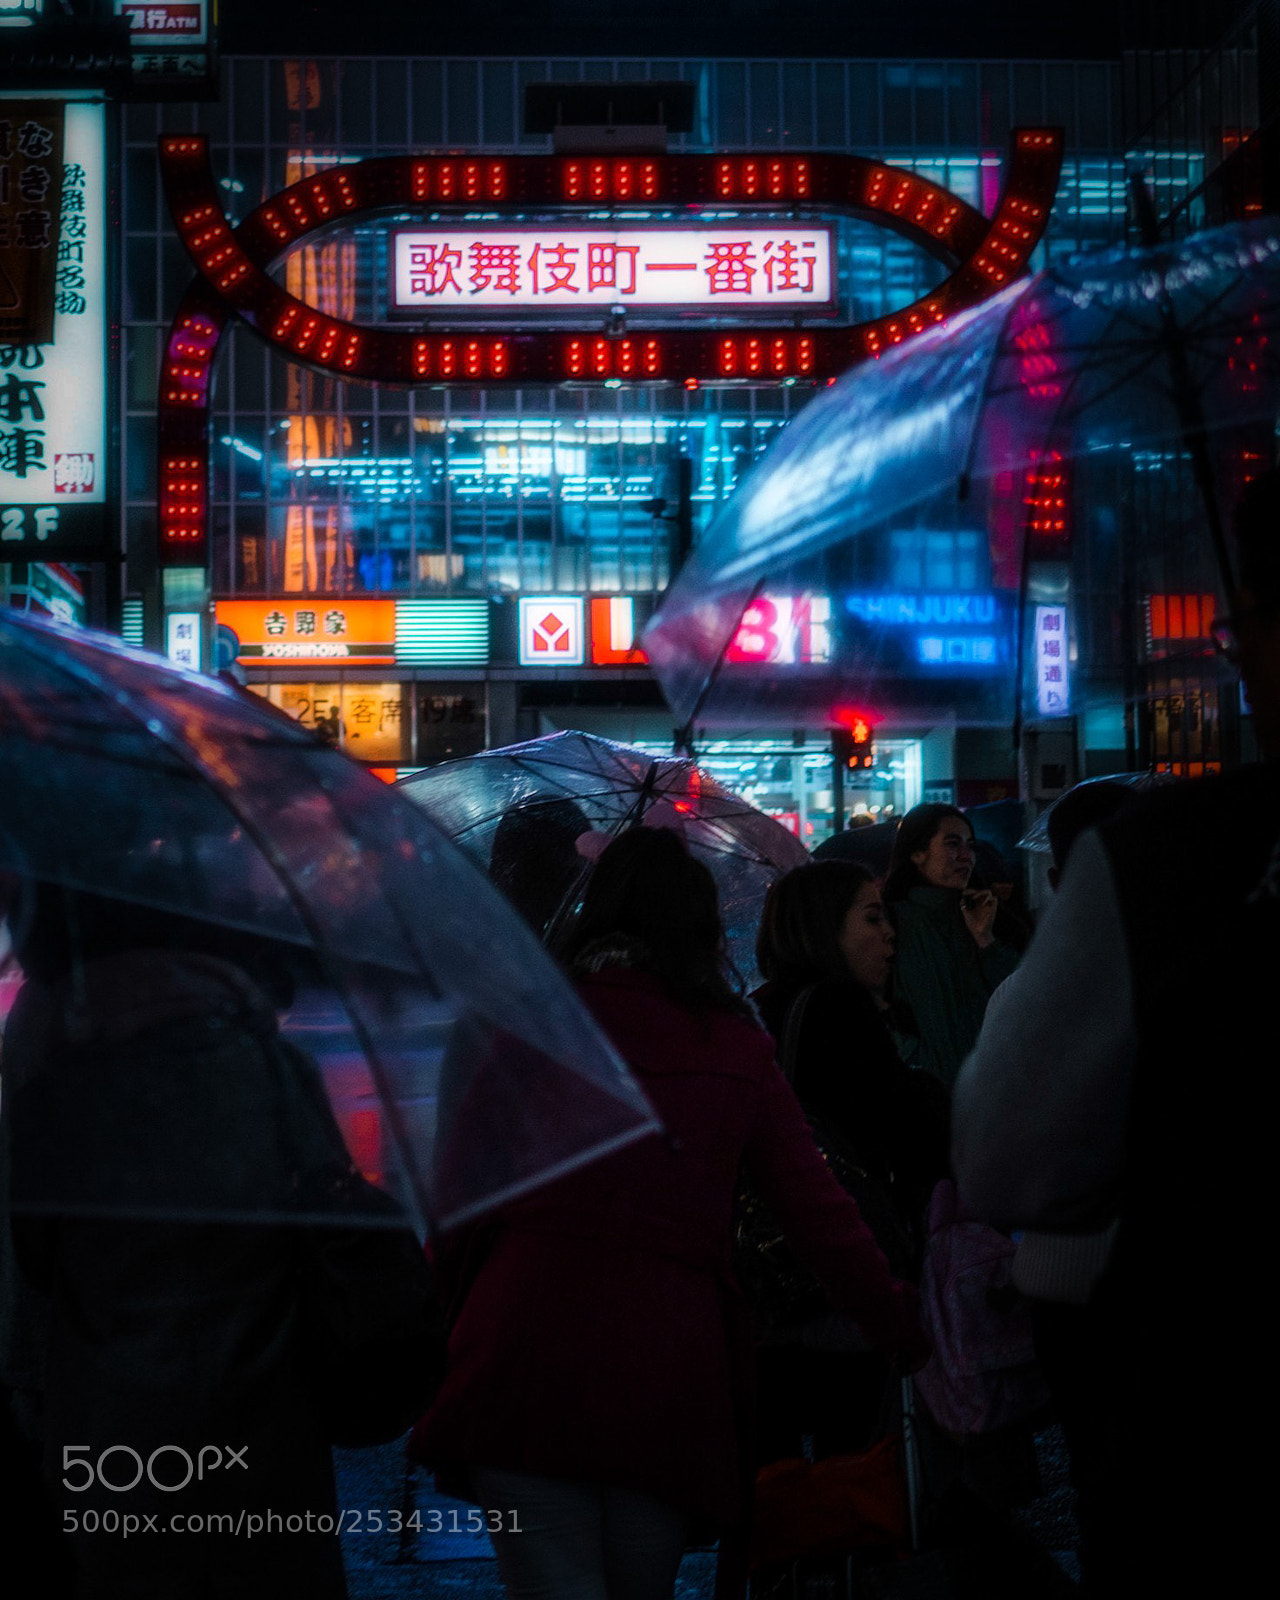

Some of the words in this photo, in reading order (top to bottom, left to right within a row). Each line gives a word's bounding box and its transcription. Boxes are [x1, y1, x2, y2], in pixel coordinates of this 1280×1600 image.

[409, 241, 817, 296] 歌舞伎町一番街
[265, 610, 346, 635] 吉野家
[847, 594, 996, 623] SHINJUKU
[1042, 613, 1063, 707] 劇場通り
